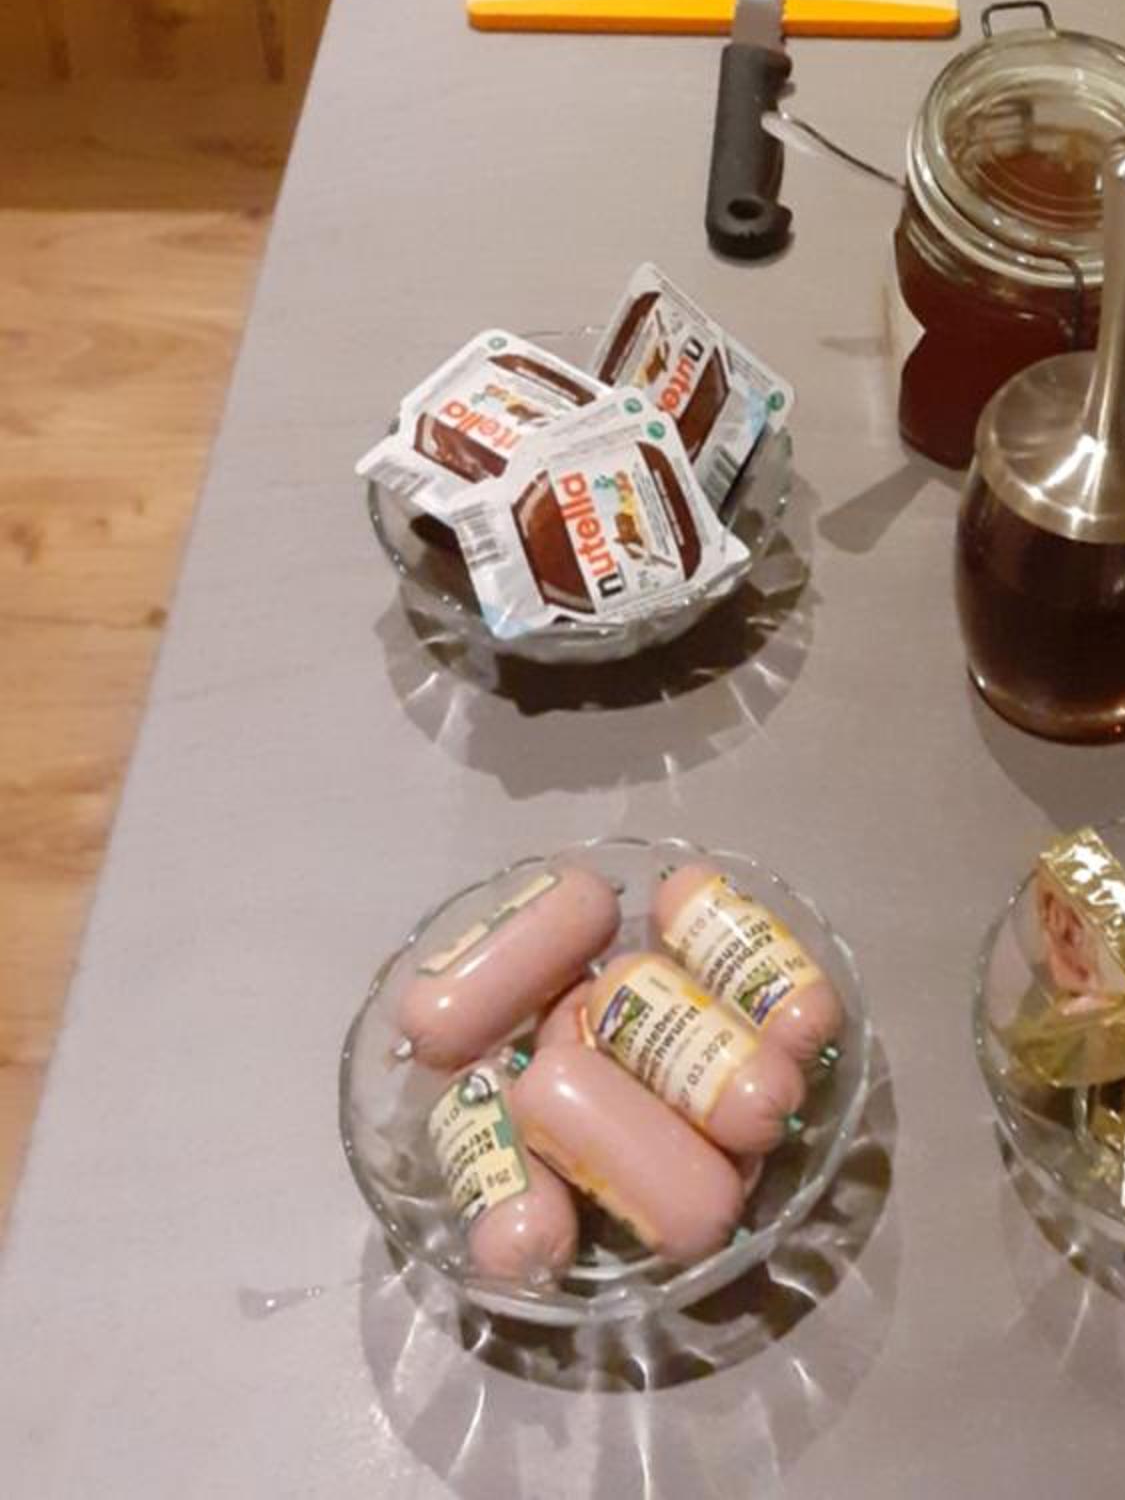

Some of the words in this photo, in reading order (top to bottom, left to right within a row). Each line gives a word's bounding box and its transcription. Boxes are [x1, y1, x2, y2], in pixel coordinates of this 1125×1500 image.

[657, 335, 704, 412] nute
[440, 400, 521, 450] tella
[558, 472, 626, 598] nutella
